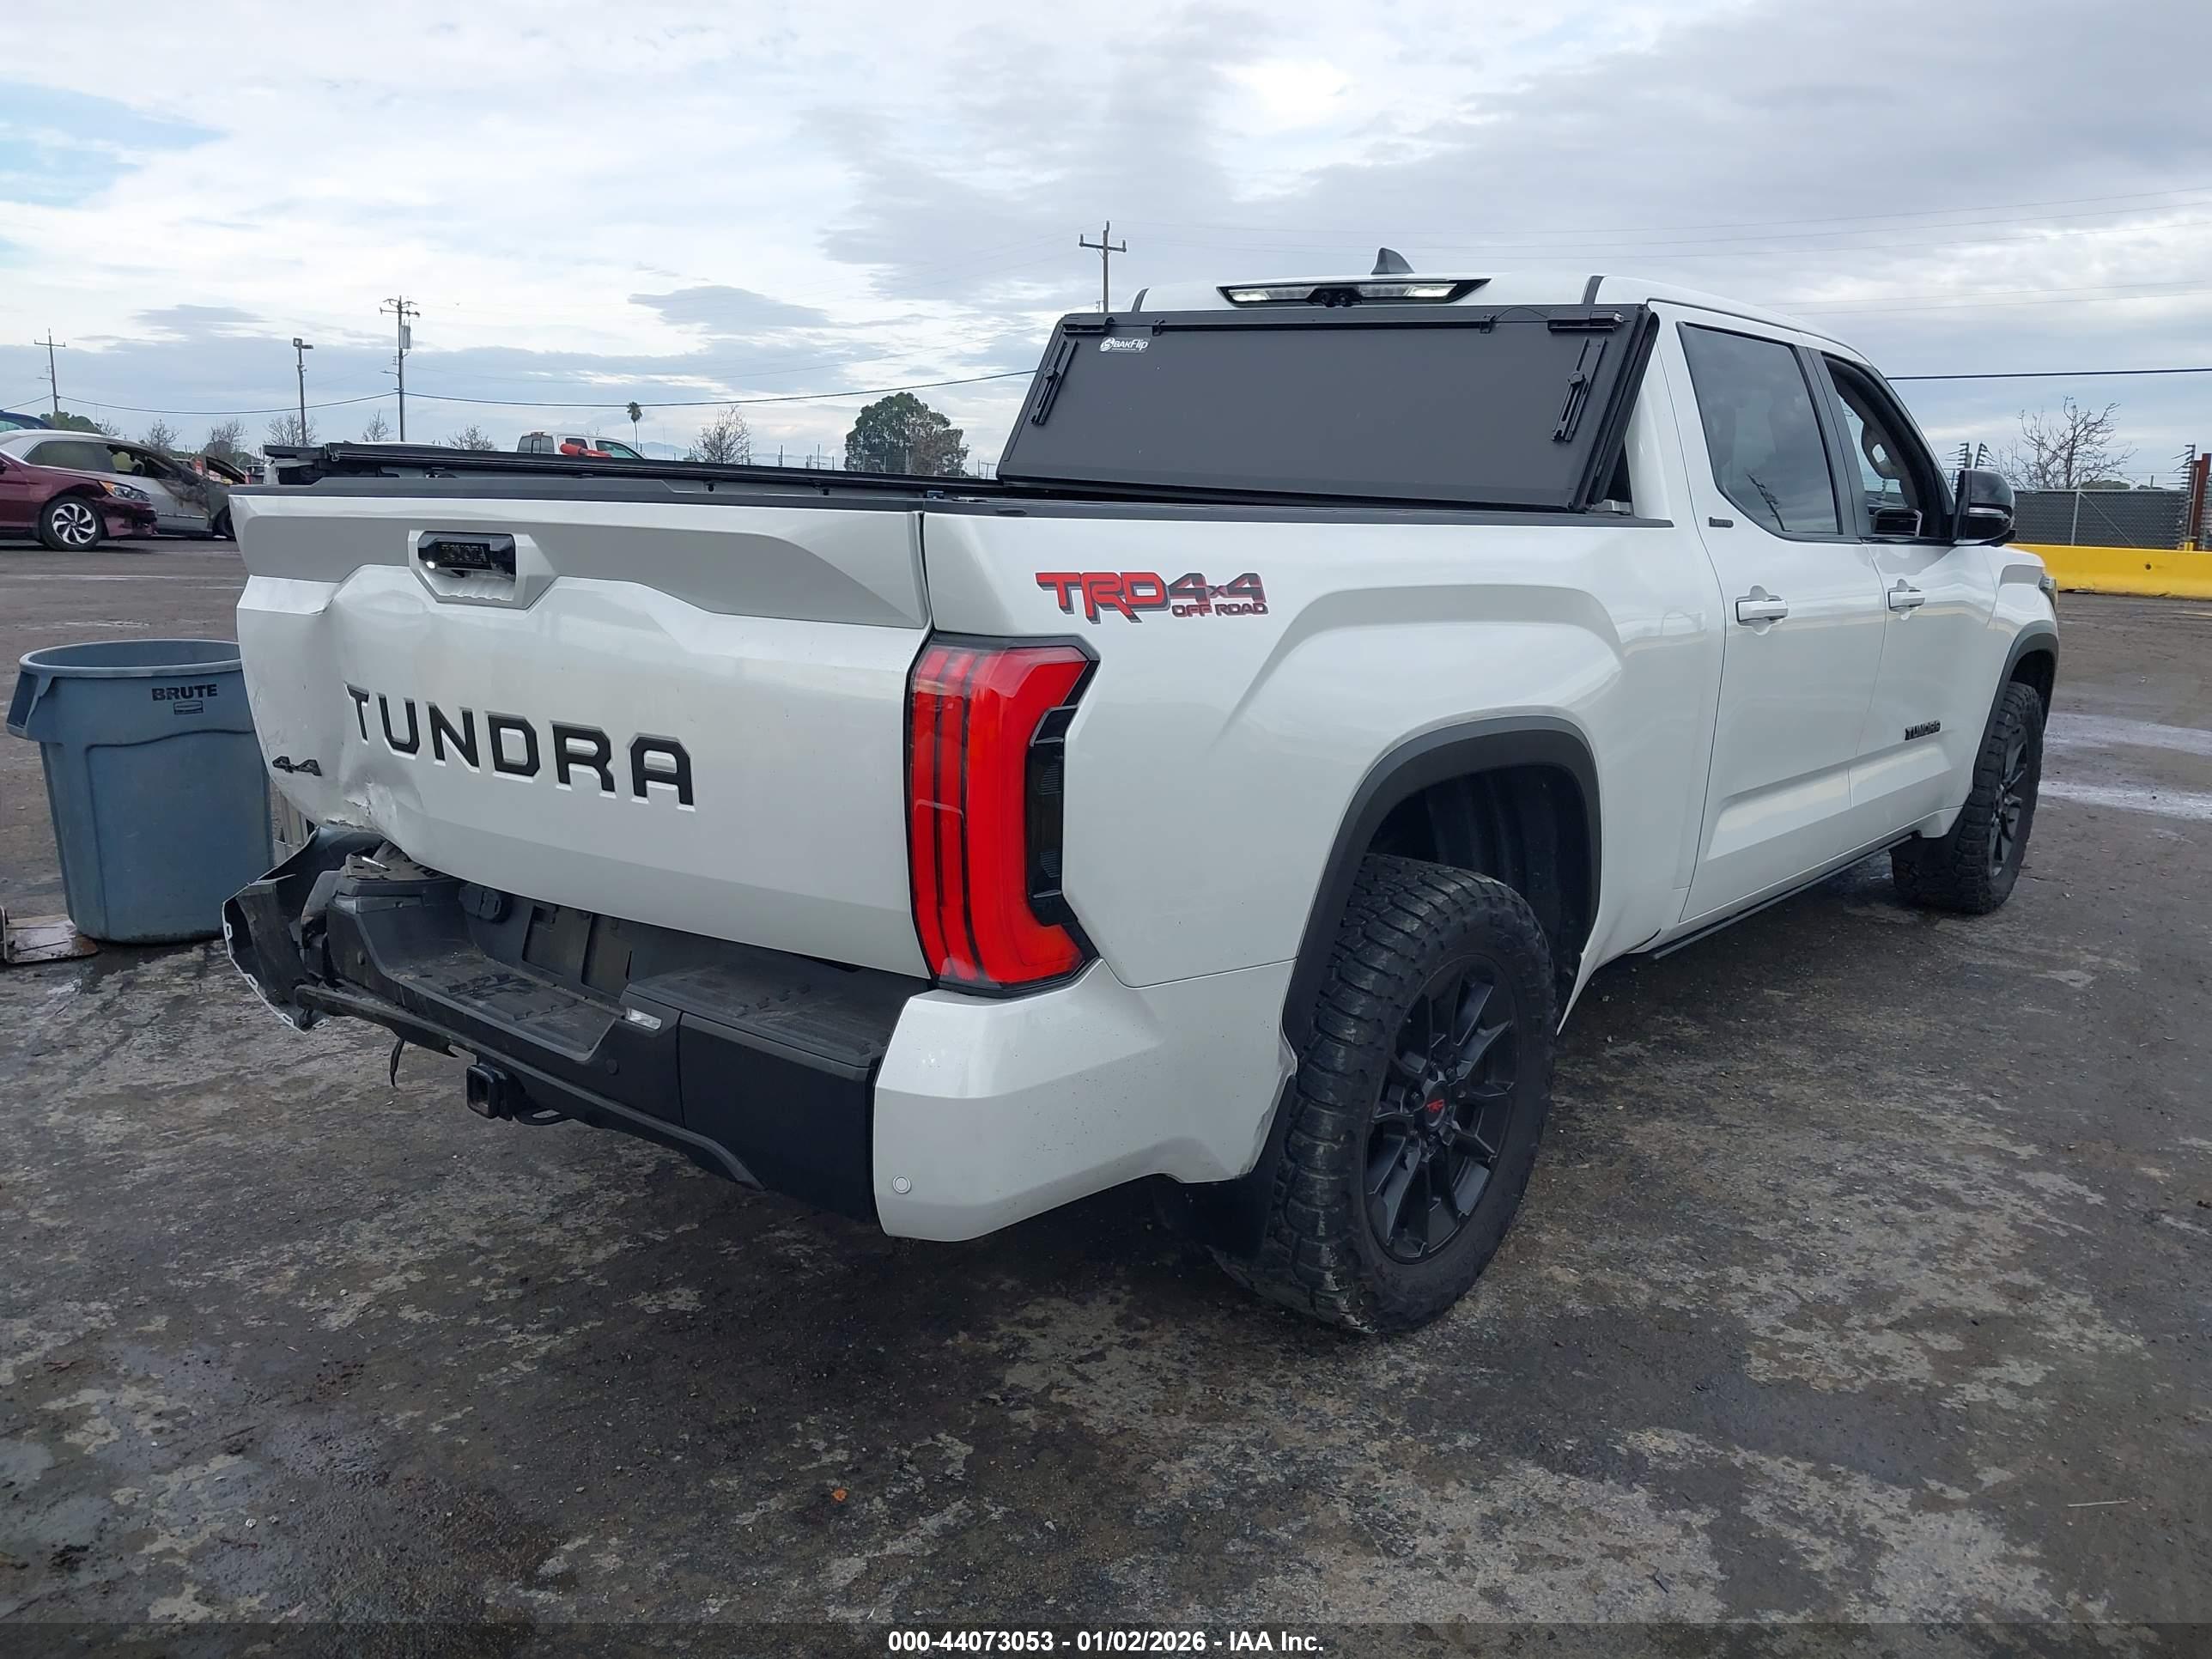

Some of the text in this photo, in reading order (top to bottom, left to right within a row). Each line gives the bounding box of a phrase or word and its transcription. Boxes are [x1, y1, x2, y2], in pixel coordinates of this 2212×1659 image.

[441, 544, 489, 562] TOYOTA
[1035, 572, 1170, 624] TRD
[1171, 602, 1268, 617] OFF ROAD
[152, 684, 217, 701] BRUTE
[345, 683, 696, 811] TUNDRA
